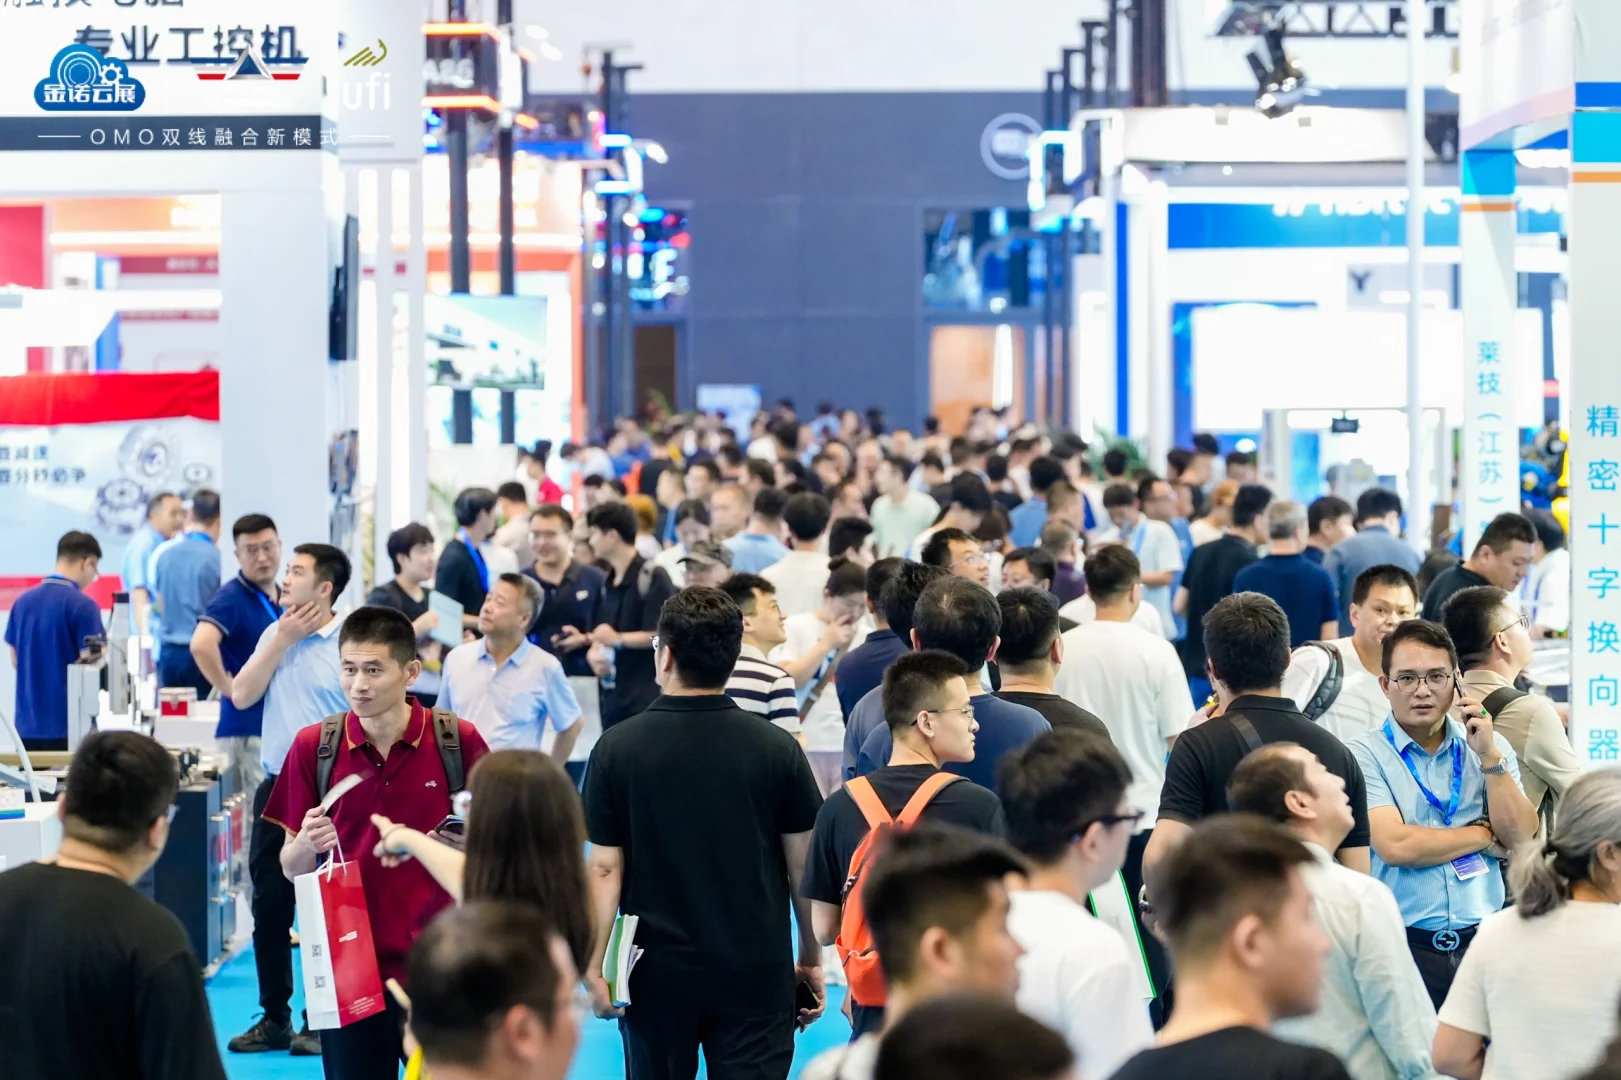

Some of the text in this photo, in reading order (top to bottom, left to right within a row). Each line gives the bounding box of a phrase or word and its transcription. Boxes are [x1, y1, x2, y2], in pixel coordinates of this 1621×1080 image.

[73, 24, 305, 64] 专业工控机
[1586, 404, 1620, 761] 精密十字换向器
